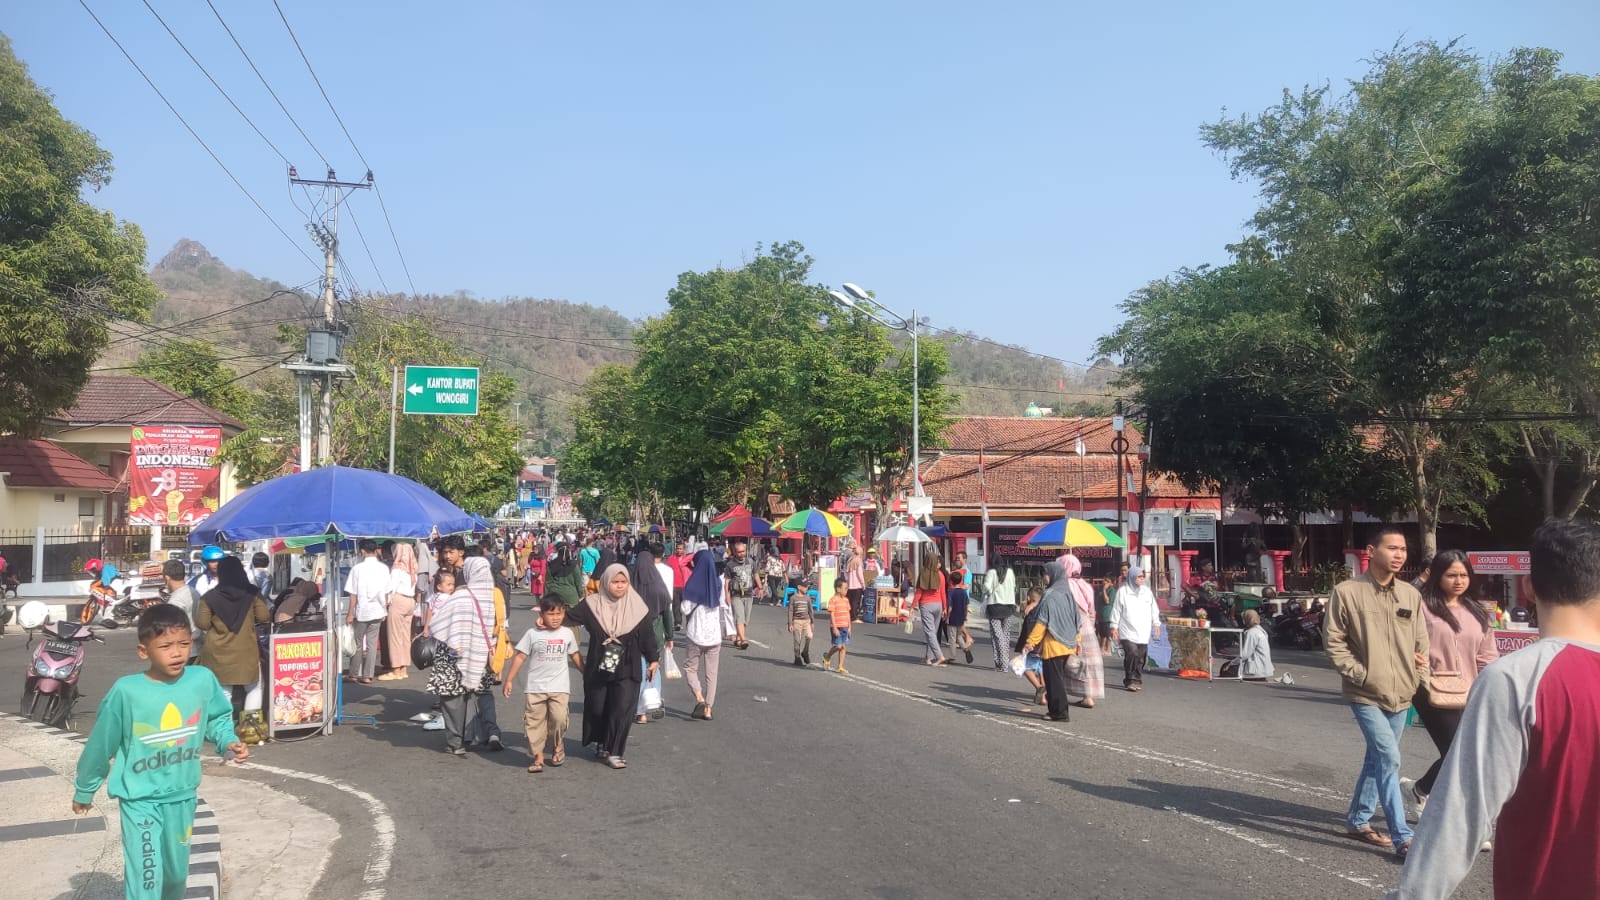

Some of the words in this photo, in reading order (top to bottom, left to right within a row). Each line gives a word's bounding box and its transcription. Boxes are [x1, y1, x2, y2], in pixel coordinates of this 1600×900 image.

[427, 377, 452, 389] KANTOR
[454, 378, 476, 390] BUPATI
[436, 392, 469, 405] WONOGIRI
[276, 641, 322, 660] TAKOYAKI
[279, 661, 309, 672] TOPPING
[131, 746, 202, 775] adidas
[141, 830, 157, 891] adidas
